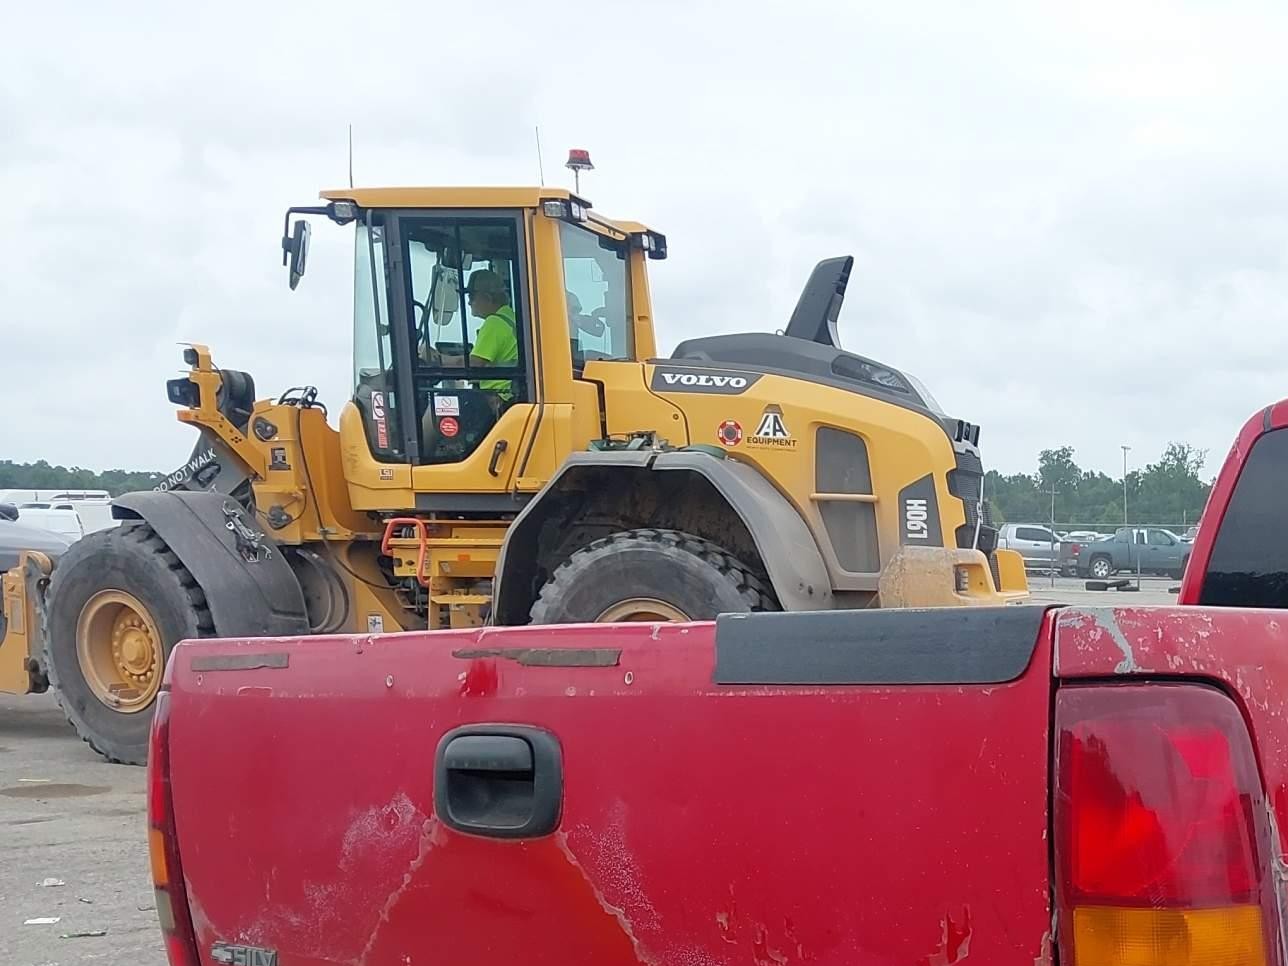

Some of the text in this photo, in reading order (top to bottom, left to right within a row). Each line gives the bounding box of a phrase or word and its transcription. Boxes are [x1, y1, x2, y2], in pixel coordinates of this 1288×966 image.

[661, 373, 747, 388] VOLVO
[168, 467, 189, 488] NOT
[188, 448, 217, 472] WALK
[906, 499, 928, 539] L90H
